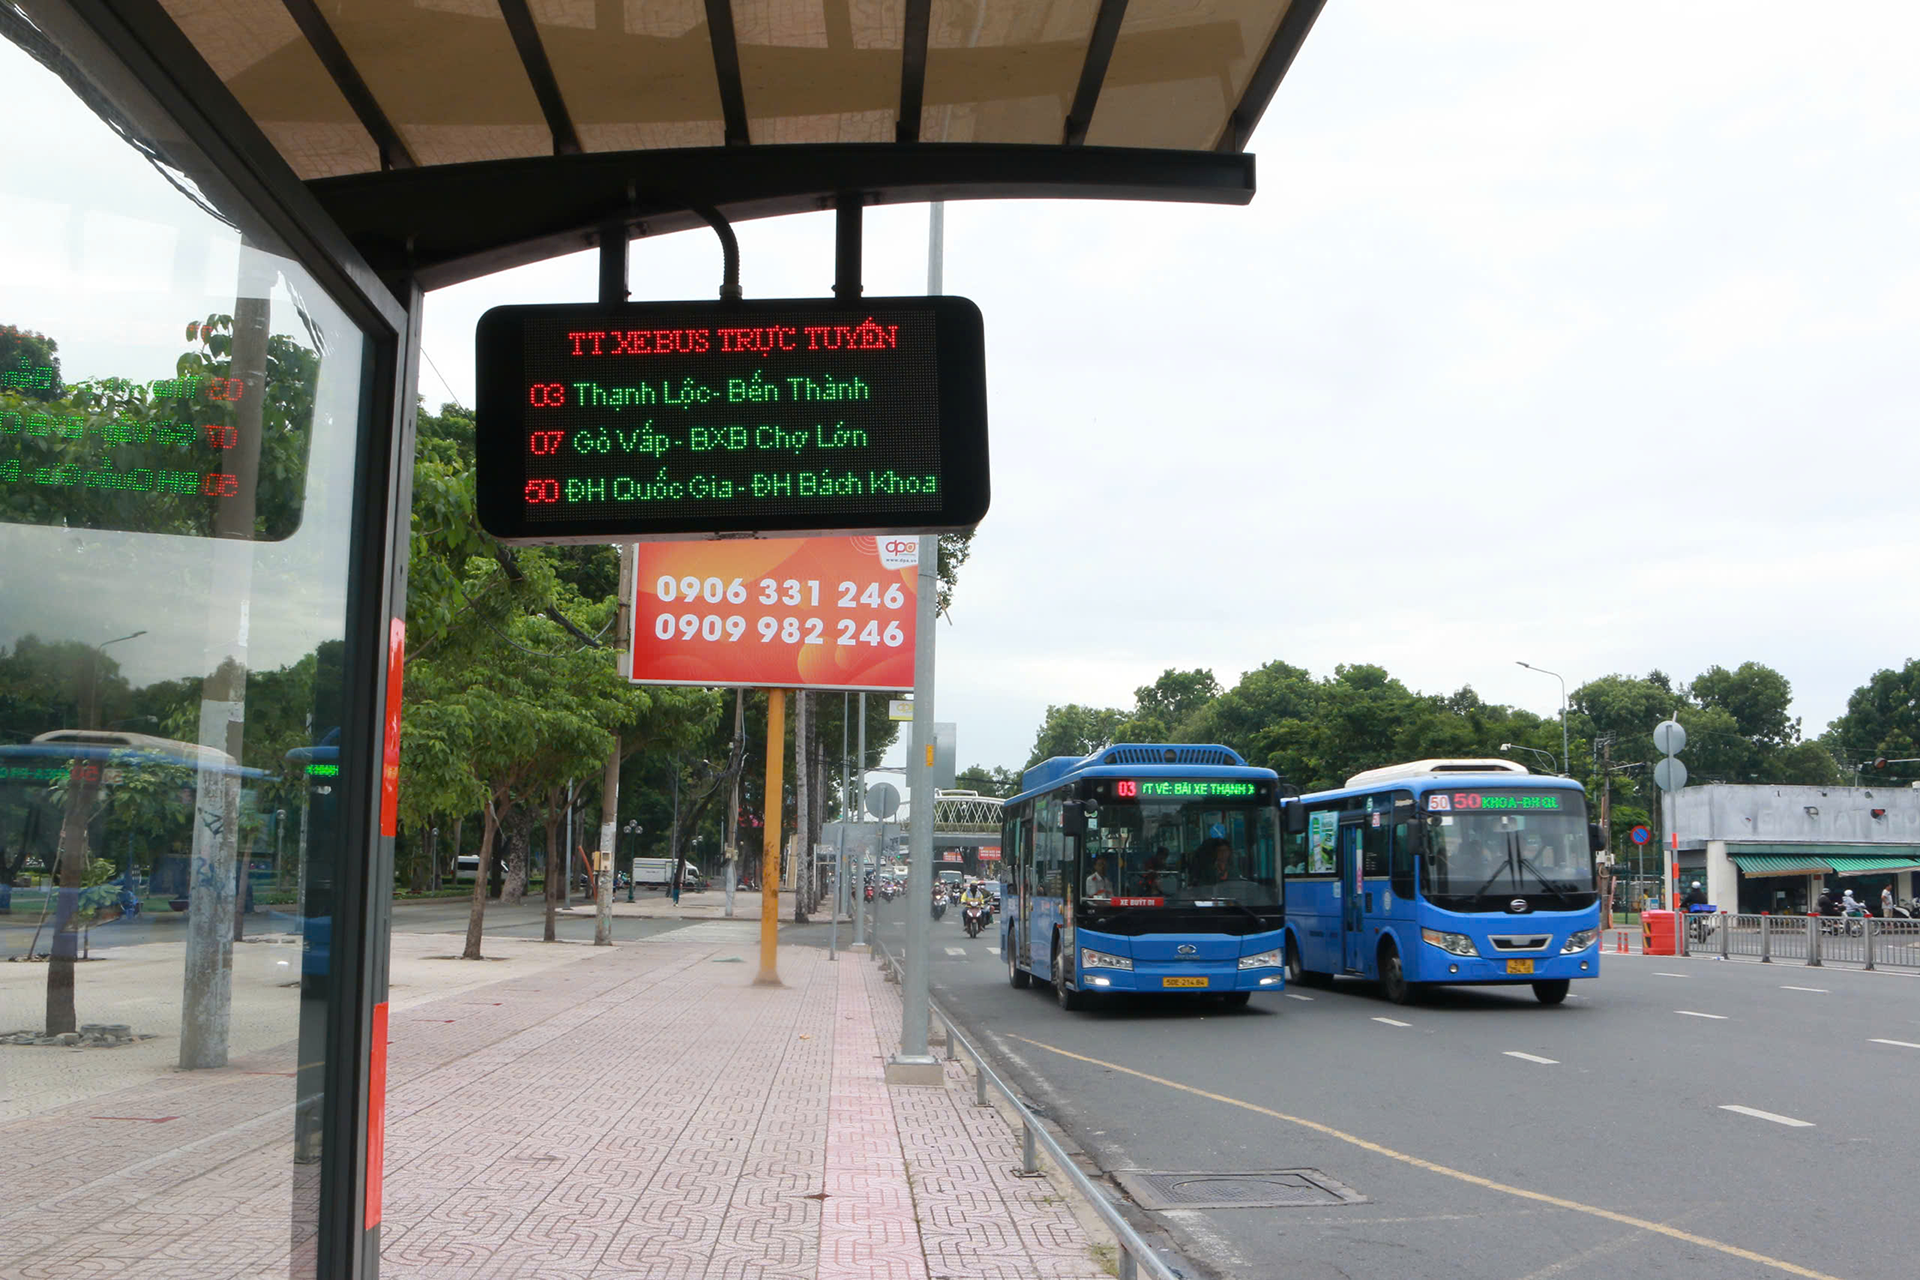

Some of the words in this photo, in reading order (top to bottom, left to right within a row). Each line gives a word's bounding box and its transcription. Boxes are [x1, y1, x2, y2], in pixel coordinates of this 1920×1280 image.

[568, 331, 606, 356] TT
[717, 324, 798, 358] TRỰC
[804, 316, 899, 350] TUYẾN
[530, 383, 566, 407] 03
[573, 381, 656, 412] Thạnh
[727, 369, 779, 403] Bến
[786, 373, 870, 401] Thành
[530, 430, 566, 456] 07
[573, 426, 611, 454] Gò
[615, 419, 669, 458] Vấp
[690, 426, 748, 452] BXB
[756, 425, 810, 455] Chợ
[816, 420, 868, 449] Lớn
[523, 478, 561, 505] 50
[564, 477, 606, 504] ĐH
[612, 466, 684, 502] Quốc
[688, 474, 733, 499] Gia
[751, 473, 792, 499] ĐH
[798, 467, 862, 497] Bách
[870, 469, 937, 495] Khoa
[656, 575, 747, 605] 0906
[758, 578, 820, 606] 331
[837, 581, 905, 610] 246
[655, 613, 747, 642] 0909
[757, 616, 824, 645] 982
[836, 619, 905, 647] 246
[1118, 780, 1137, 797] 03
[1193, 782, 1208, 796] XE
[1430, 796, 1448, 809] 50
[1454, 792, 1481, 809] 50
